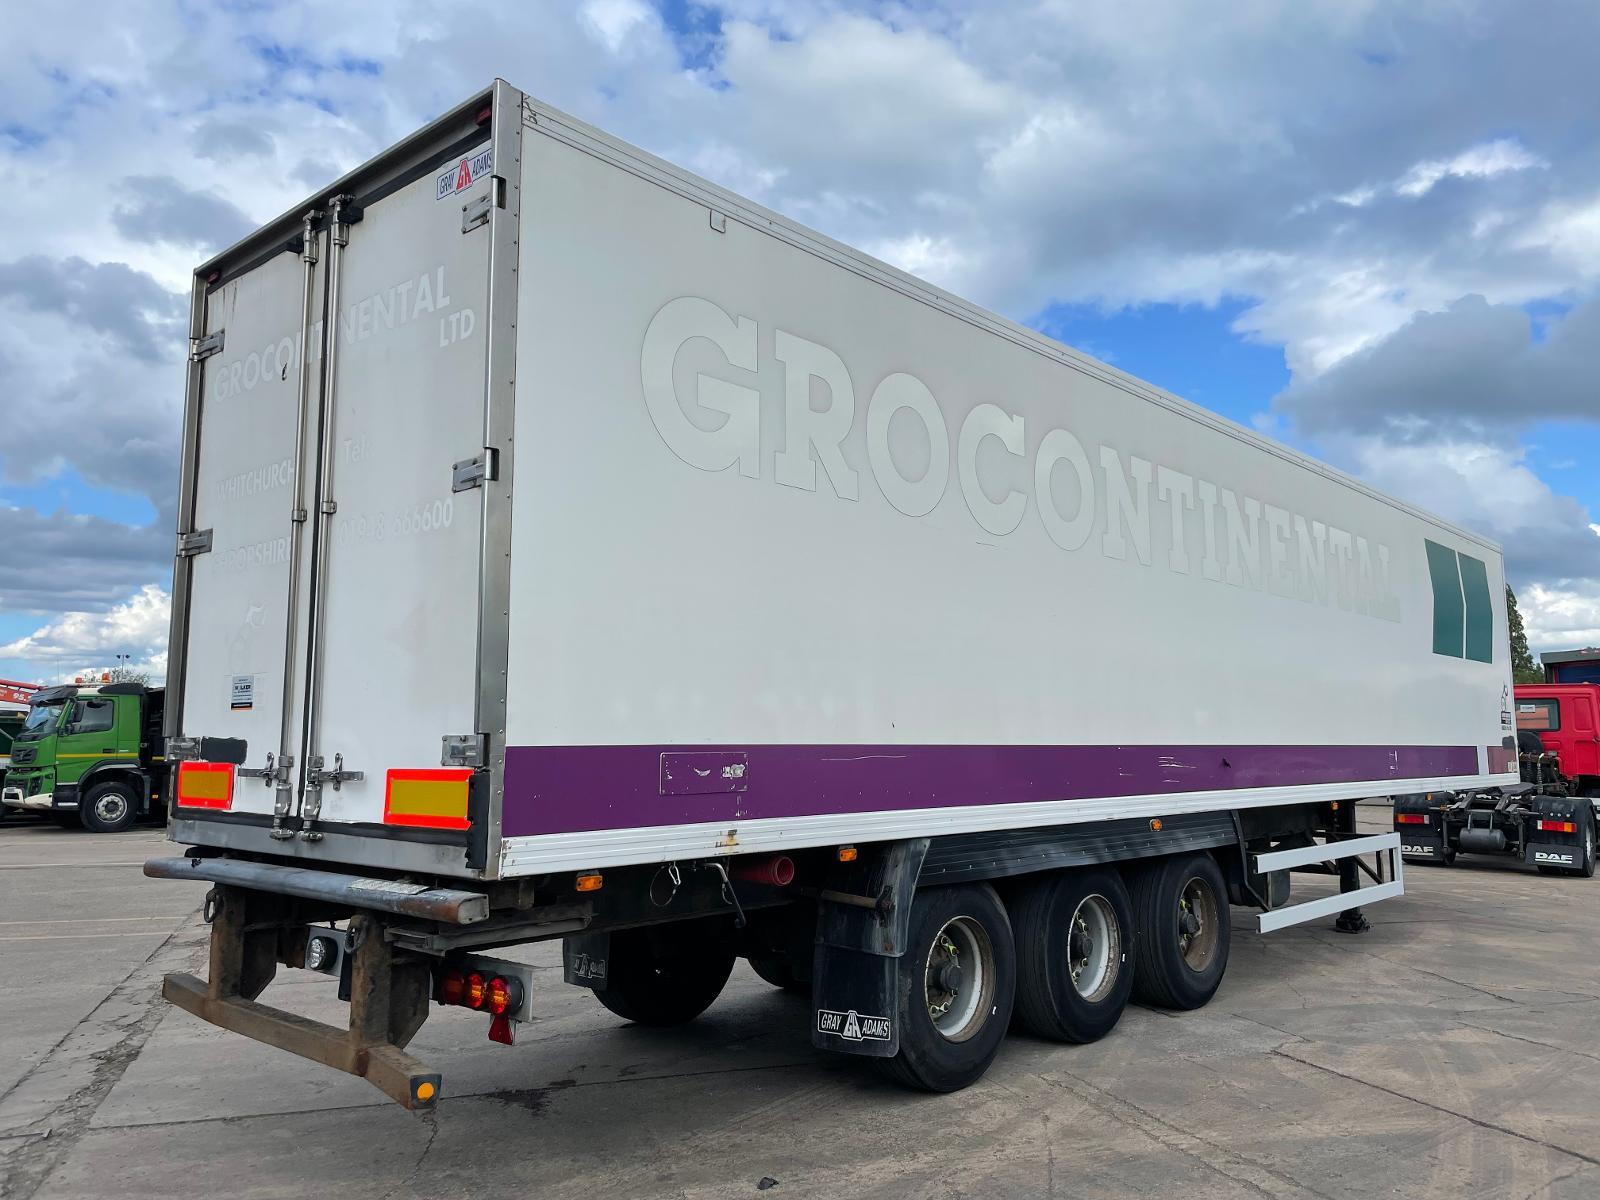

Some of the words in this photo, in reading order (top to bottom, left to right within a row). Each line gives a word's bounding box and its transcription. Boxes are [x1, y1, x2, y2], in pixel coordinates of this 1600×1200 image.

[440, 172, 455, 195] GRAY
[439, 308, 475, 348] LTD
[640, 296, 1401, 622] GROCONTINENTAL
[215, 458, 295, 502] WHITCHURCH
[391, 496, 454, 538] 666600
[1401, 844, 1434, 853] DAF
[1534, 851, 1573, 862] DAF
[821, 1013, 842, 1030] GRAY
[862, 1019, 889, 1036] ADAMS
